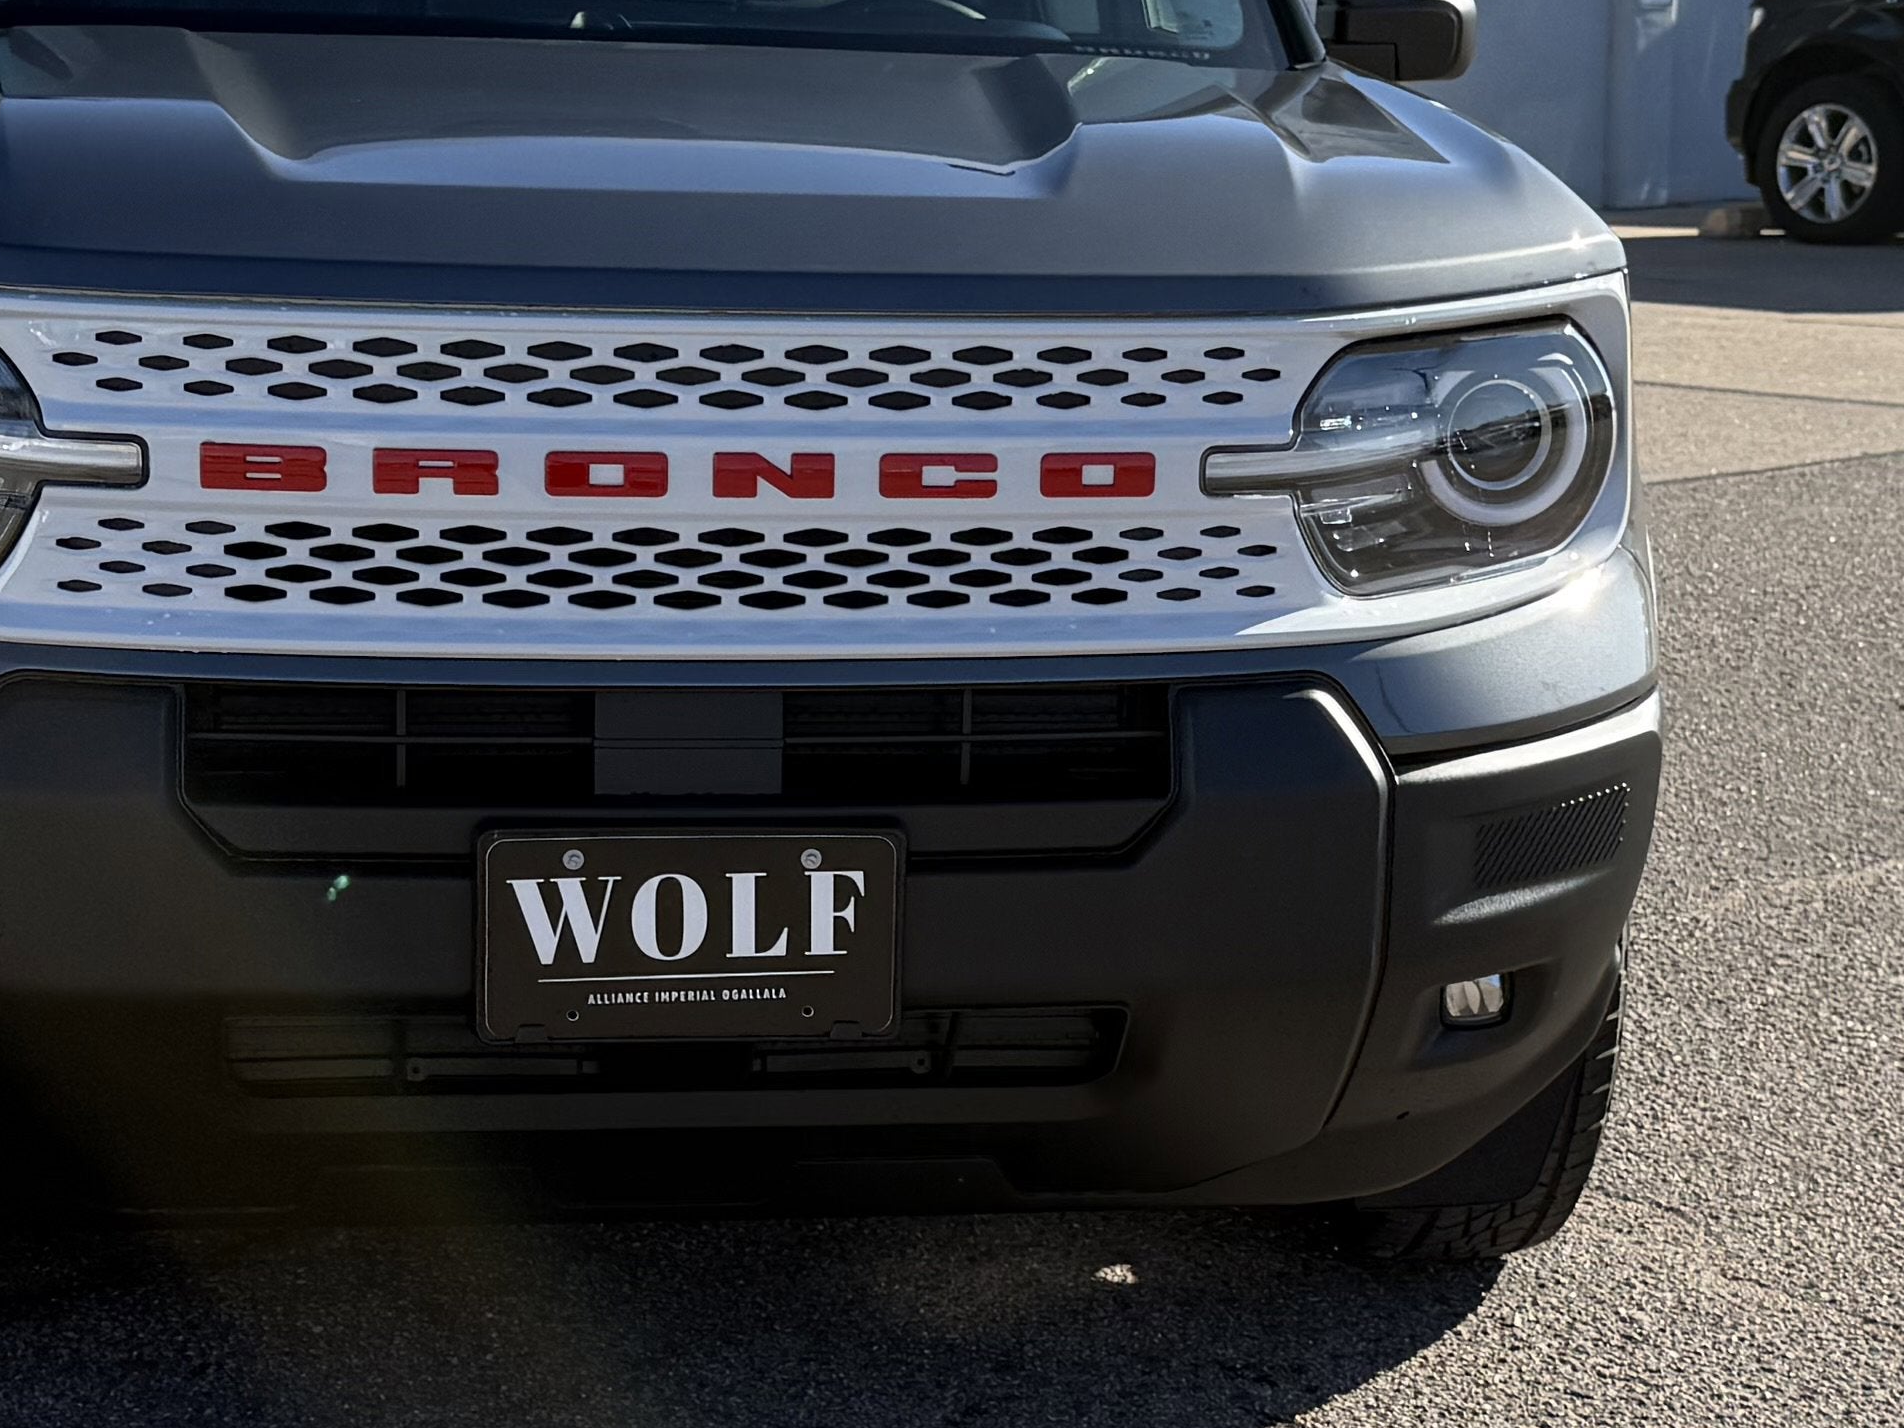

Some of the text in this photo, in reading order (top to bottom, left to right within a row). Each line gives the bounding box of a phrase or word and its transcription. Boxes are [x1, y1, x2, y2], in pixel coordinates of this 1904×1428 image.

[199, 441, 1156, 500] BRONCO
[506, 870, 866, 965] WOLF
[587, 987, 787, 1005] ALLIANCE IMPERIAL OGALLALA
